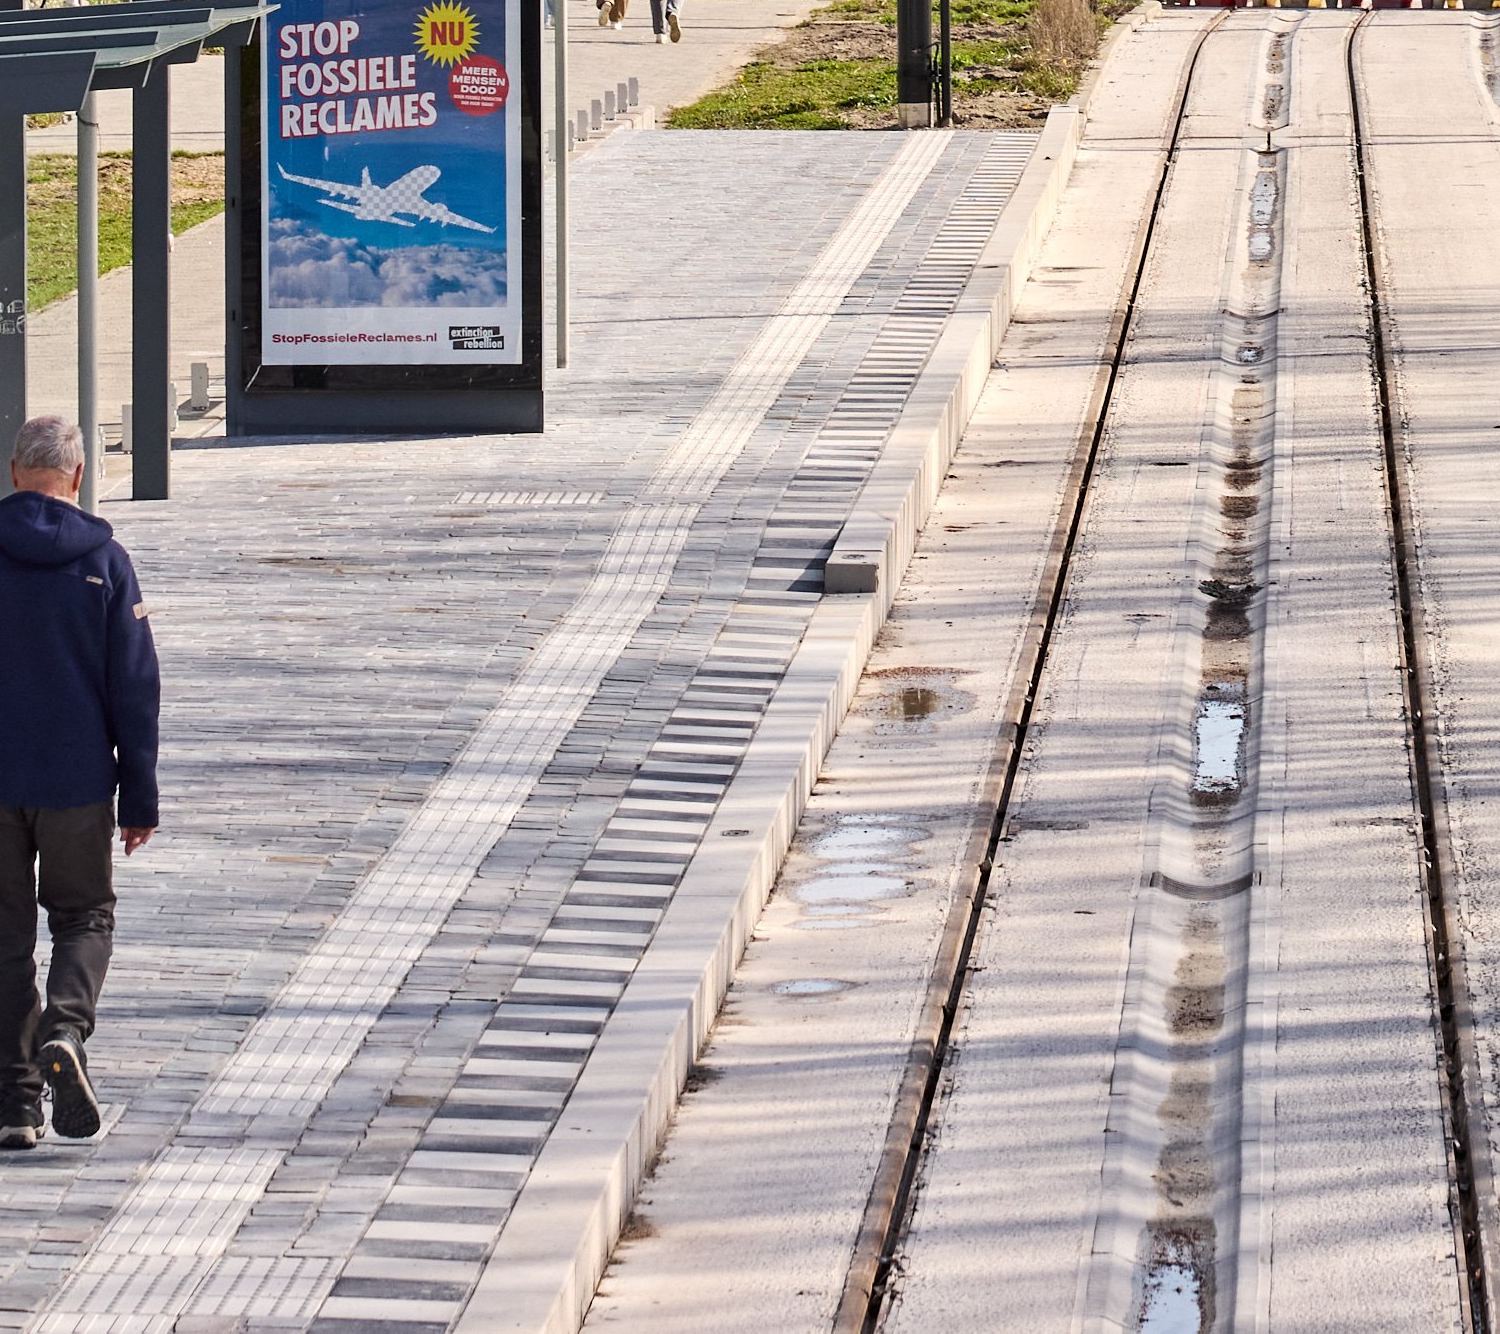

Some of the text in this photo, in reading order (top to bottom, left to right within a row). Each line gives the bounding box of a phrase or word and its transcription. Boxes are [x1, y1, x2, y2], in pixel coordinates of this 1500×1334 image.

[278, 19, 360, 60] STOP
[430, 20, 465, 47] NU
[280, 53, 417, 99] FOSSIELE
[462, 65, 498, 77] MEER
[452, 74, 506, 87] MENSEN
[460, 84, 497, 95] DOOD
[281, 91, 438, 139] RECLAMES
[272, 332, 437, 345] StopFossieleReclames.nl
[451, 326, 494, 338] extinction
[463, 337, 503, 349] rebellion
